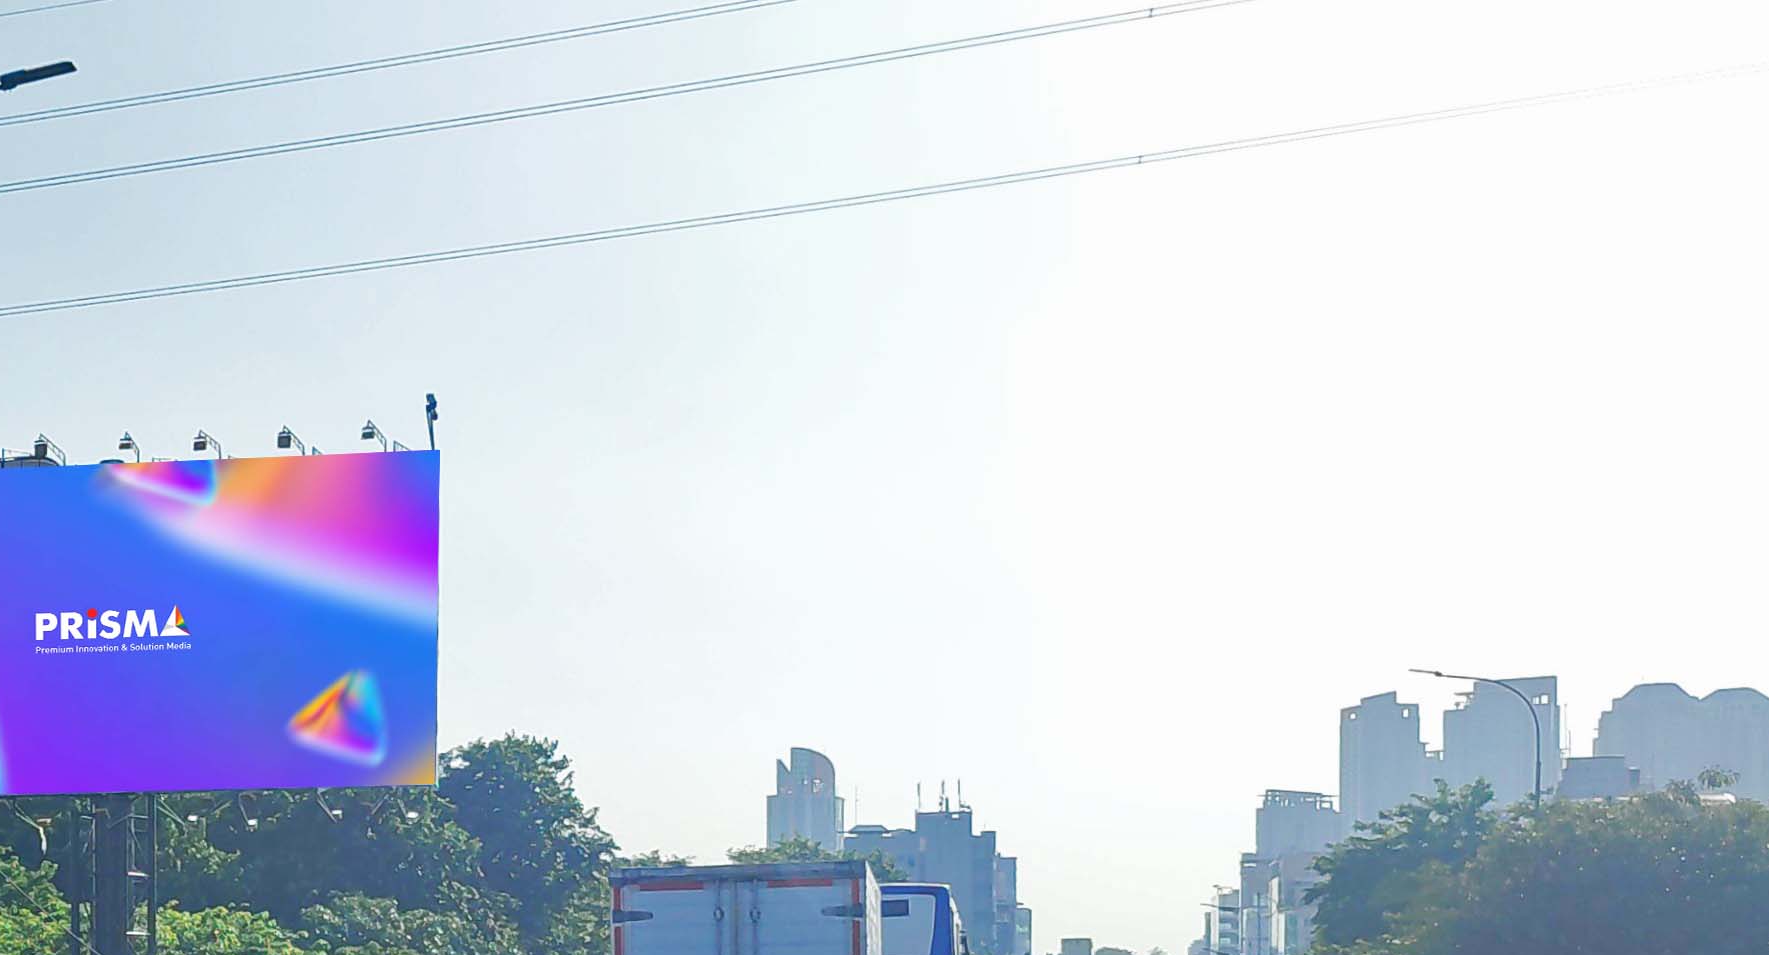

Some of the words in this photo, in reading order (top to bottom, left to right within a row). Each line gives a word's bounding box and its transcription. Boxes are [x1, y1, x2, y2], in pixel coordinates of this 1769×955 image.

[35, 645, 74, 654] Premium
[75, 643, 119, 653] Innovation
[121, 643, 128, 652] &
[130, 642, 164, 651] Solution
[166, 641, 192, 650] Media
